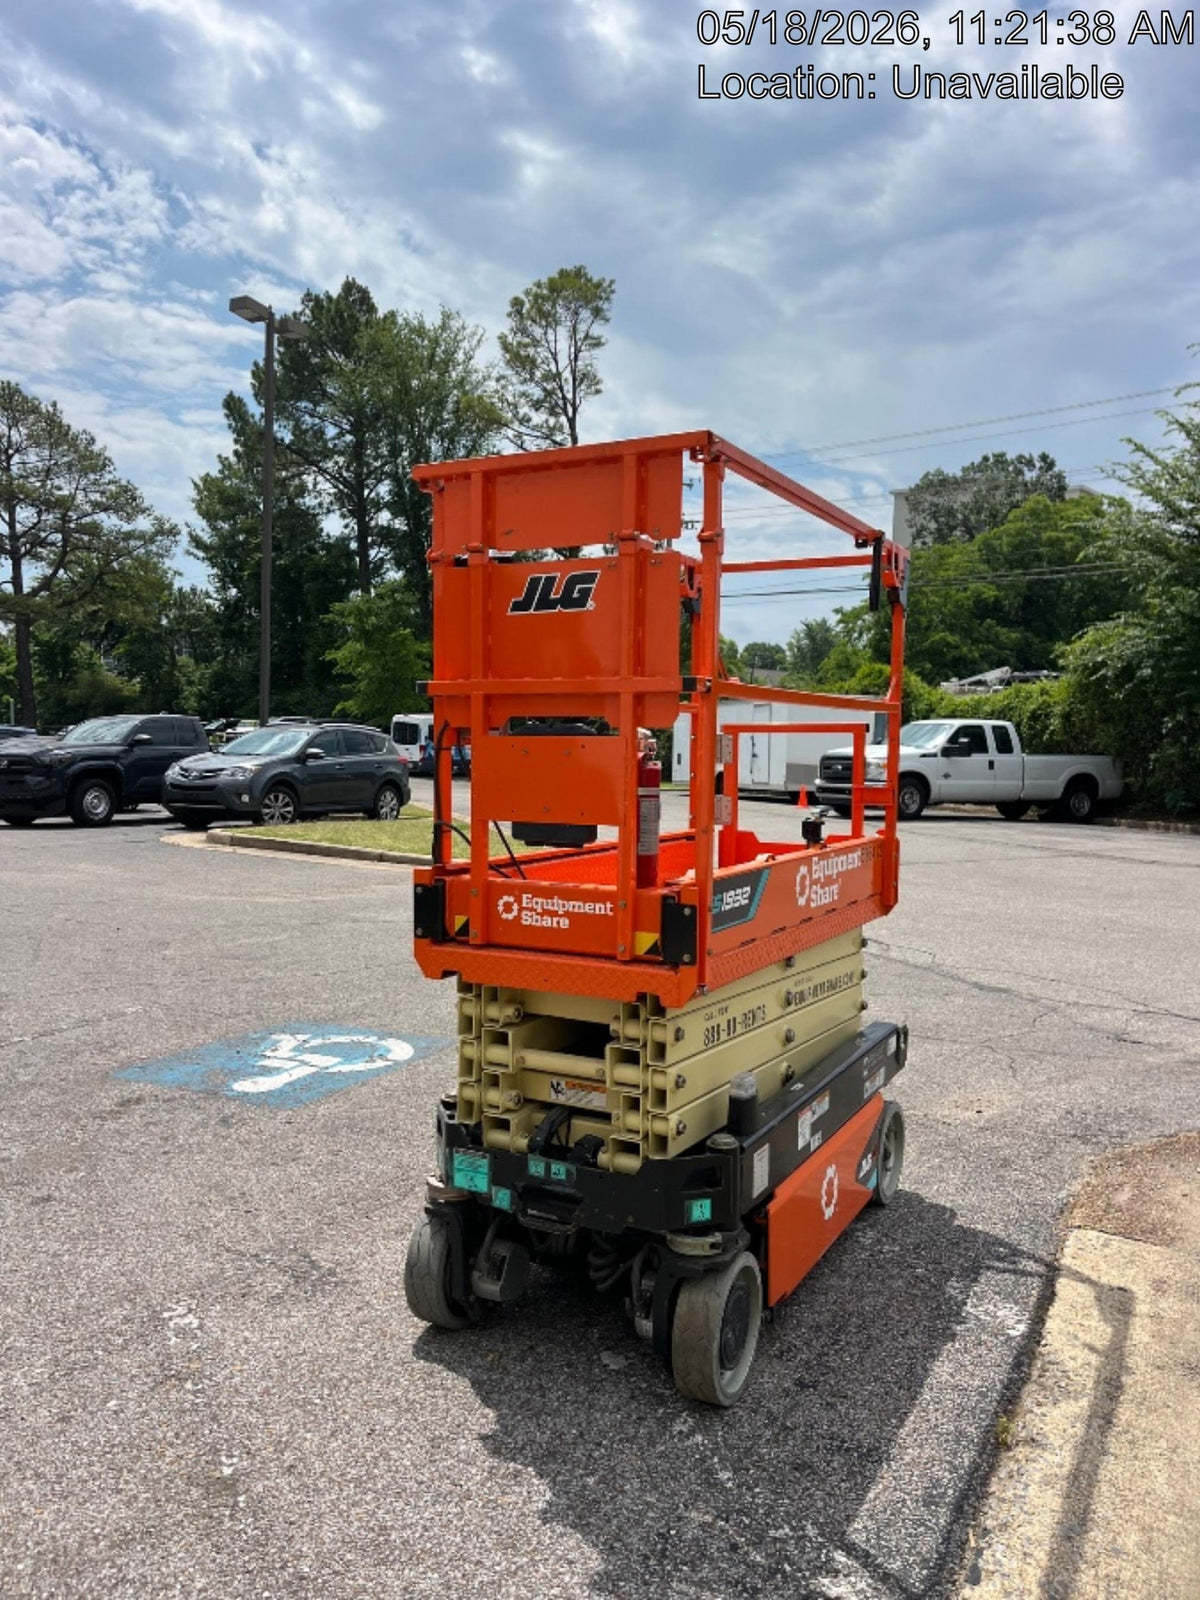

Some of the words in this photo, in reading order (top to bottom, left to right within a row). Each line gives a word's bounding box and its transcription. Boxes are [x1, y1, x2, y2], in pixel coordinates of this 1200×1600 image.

[506, 569, 602, 615] JLG
[812, 849, 862, 882] Equipment
[521, 894, 614, 917] Equipment
[711, 885, 751, 914] S1932
[810, 883, 839, 908] Share
[520, 911, 570, 929] Share
